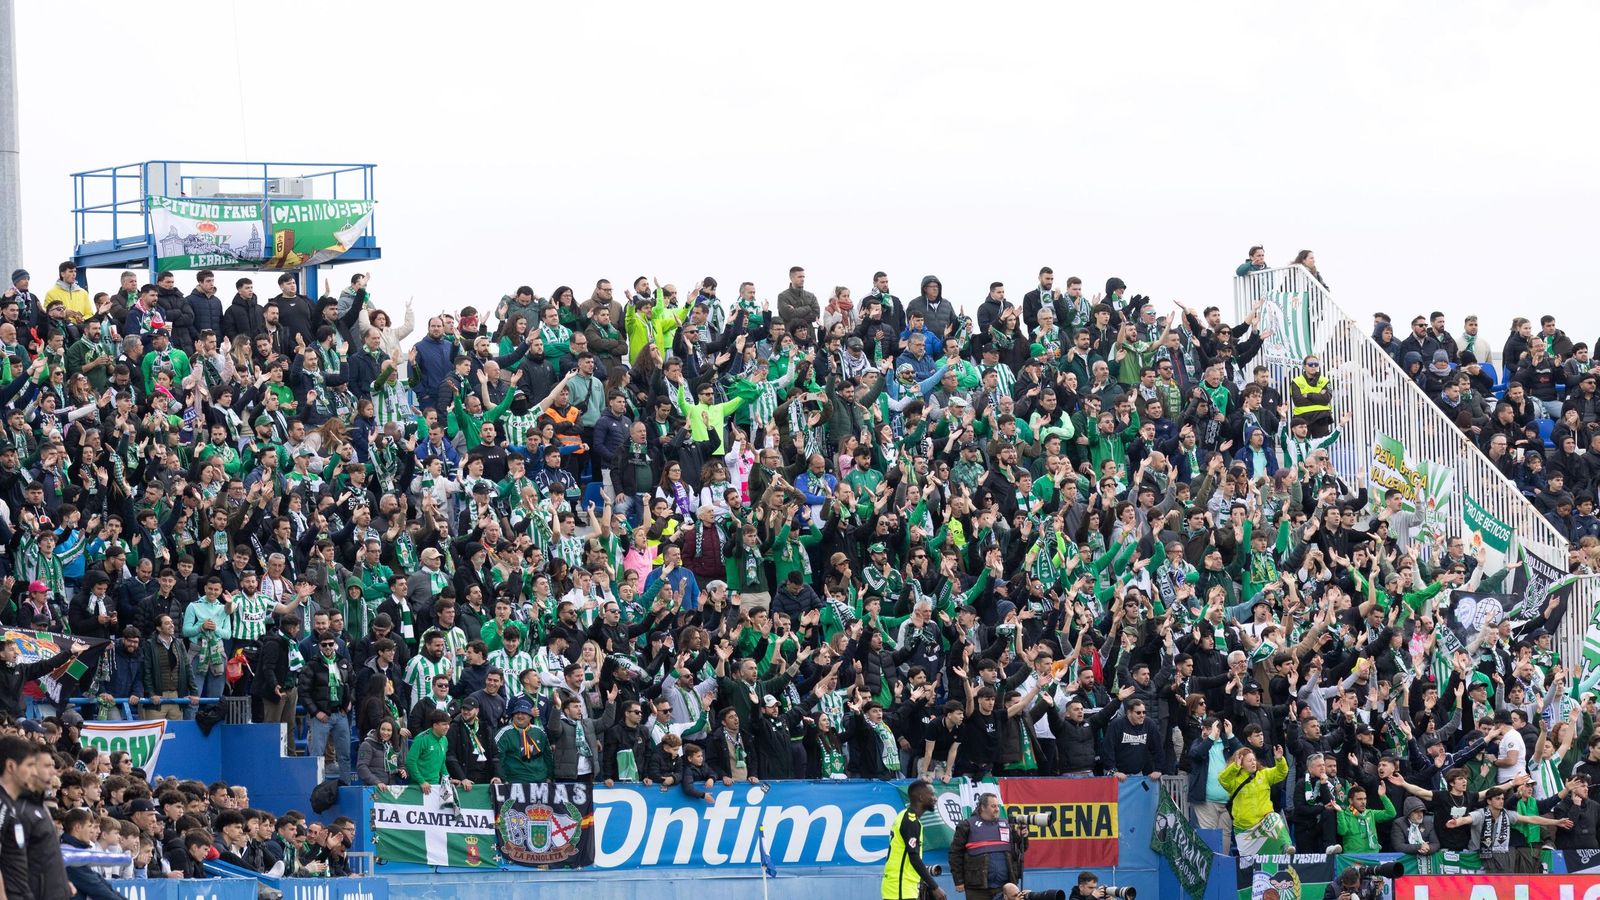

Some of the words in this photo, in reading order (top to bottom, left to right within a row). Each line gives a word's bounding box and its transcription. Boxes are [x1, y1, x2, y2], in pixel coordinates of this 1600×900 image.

[224, 205, 257, 219] FANS
[1483, 517, 1511, 542] BÉTICOS
[378, 808, 401, 824] LA
[406, 810, 489, 829] CAMPANA
[592, 786, 898, 869] Ontime
